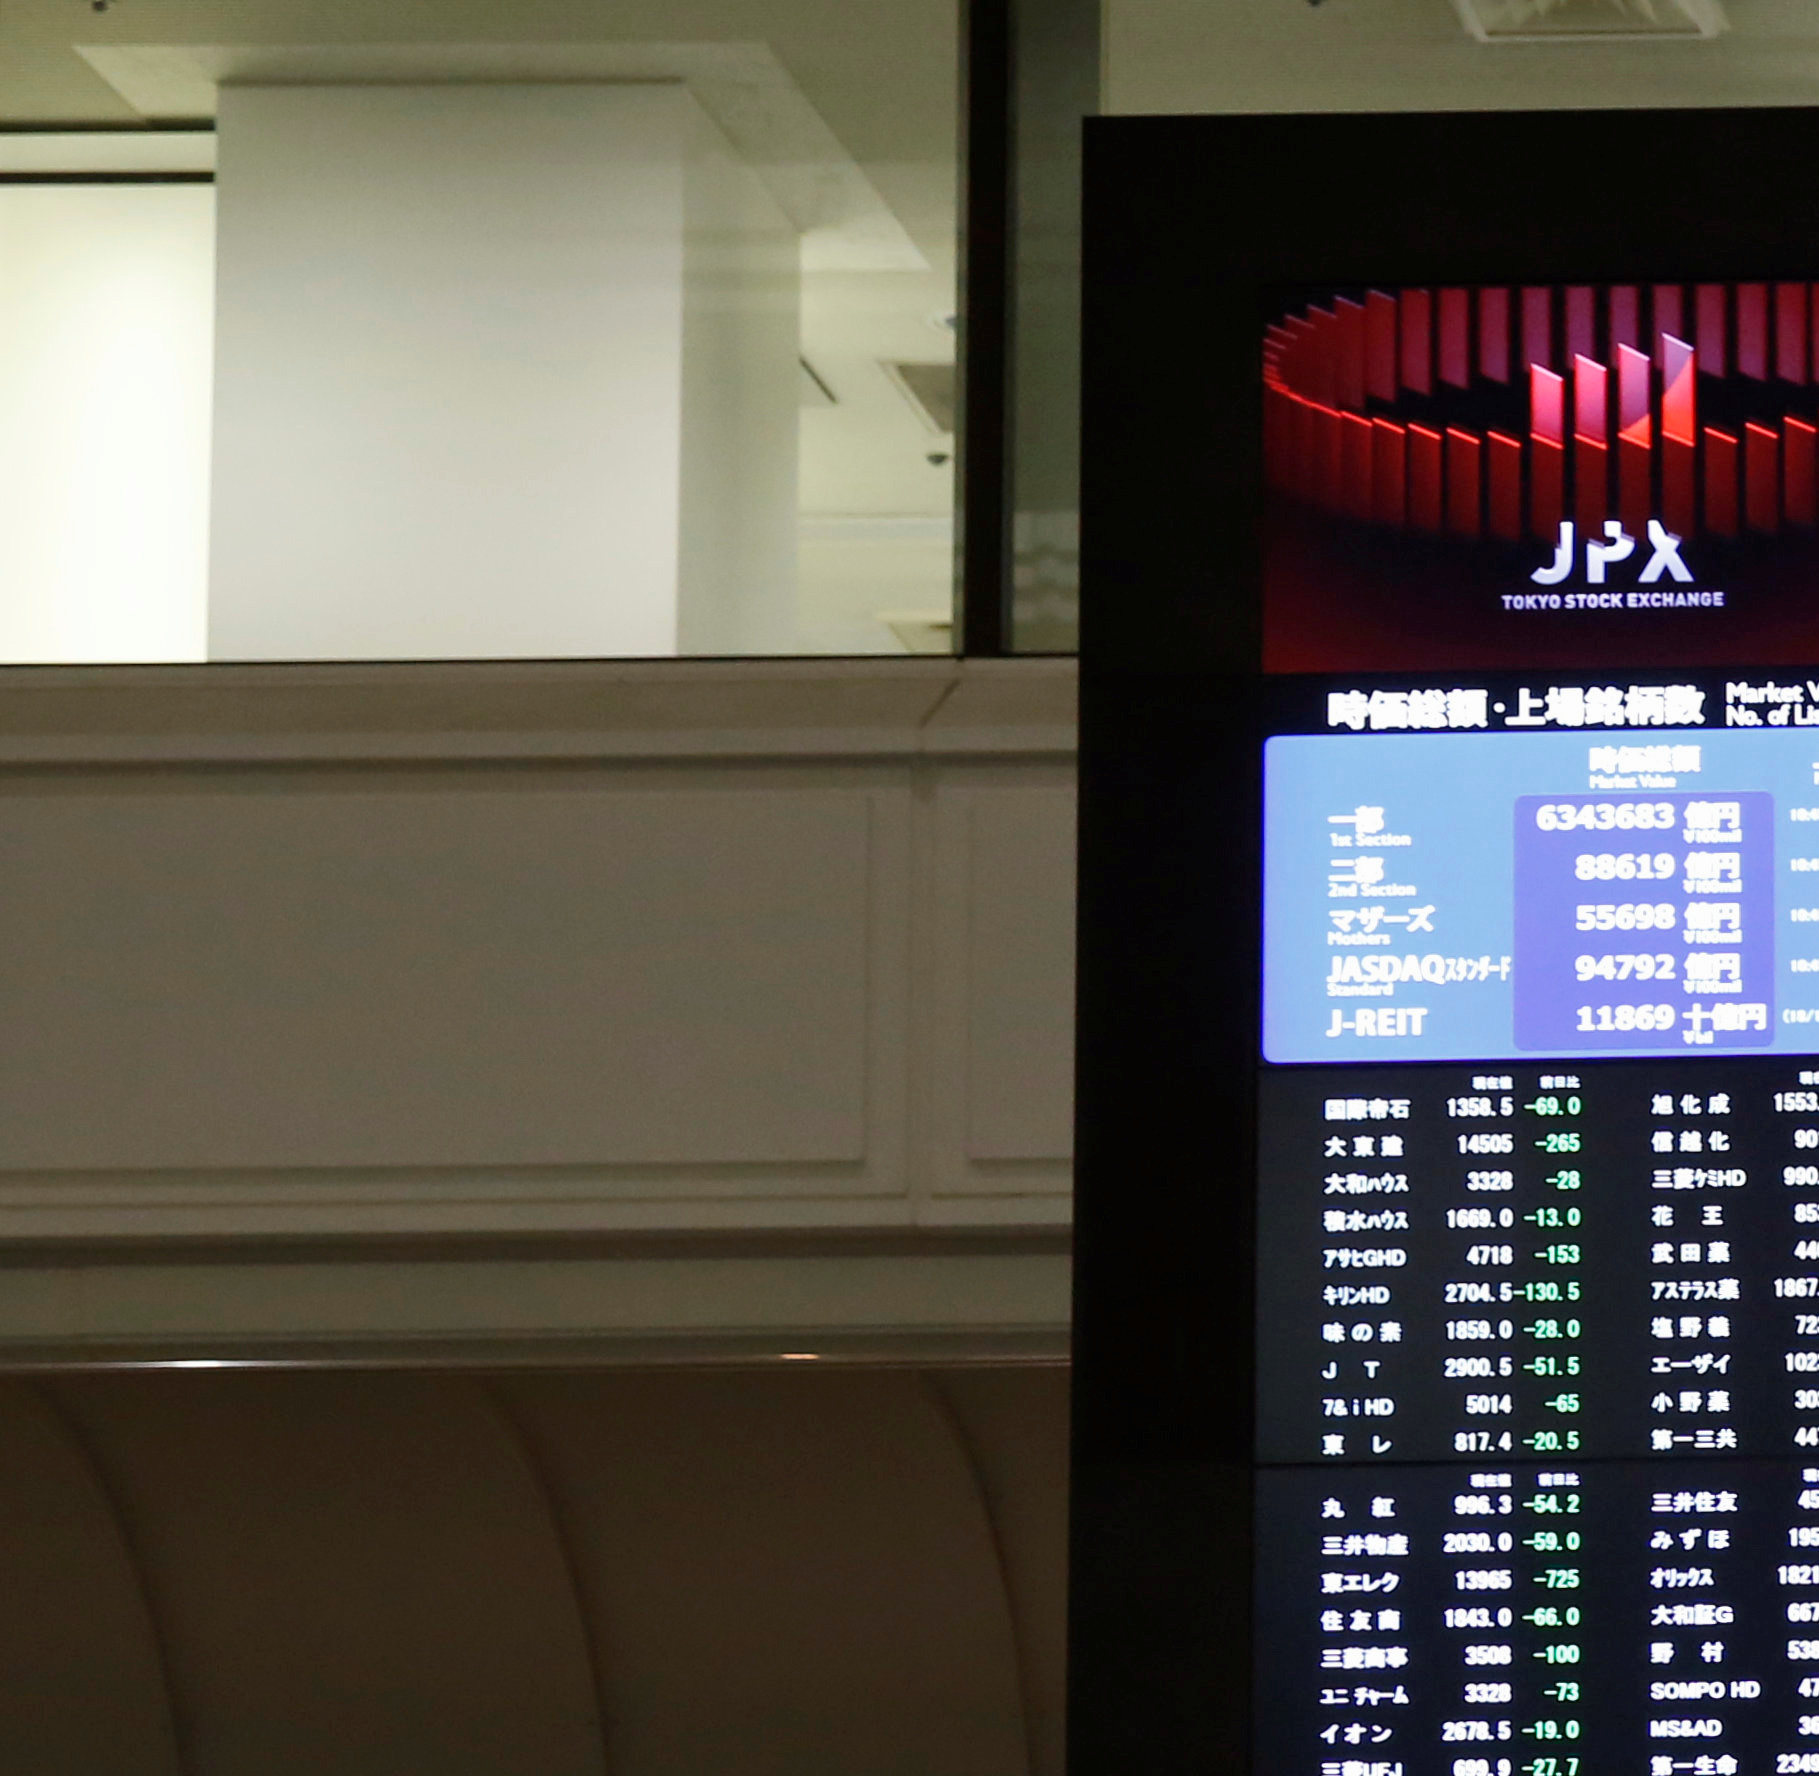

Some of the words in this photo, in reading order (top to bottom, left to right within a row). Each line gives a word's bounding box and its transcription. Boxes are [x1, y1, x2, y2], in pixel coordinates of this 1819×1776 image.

[1531, 520, 1693, 584] JPX
[1502, 595, 1561, 609] TOKYO
[1564, 593, 1623, 608] STOCK
[1627, 592, 1724, 607] EXCHANGE
[1726, 682, 1804, 703] Market
[1726, 705, 1762, 726] No.
[1765, 703, 1789, 724] of
[1328, 806, 1384, 836] 一部
[1537, 803, 1675, 830] 6343683
[1683, 801, 1740, 833] 億円
[1329, 856, 1384, 887] 二部
[1575, 853, 1675, 880] 88619
[1330, 905, 1435, 933] マザーズ
[1576, 904, 1675, 930] 55698
[1327, 955, 1511, 989] JASDAQスタンダード
[1576, 954, 1675, 981] 94792
[1326, 1008, 1427, 1037] J-REIT
[1577, 1004, 1675, 1030] 11869
[1324, 1173, 1409, 1194] 大和ハウス
[1467, 1171, 1513, 1190] 3328
[1546, 1171, 1580, 1189] -28
[1651, 1353, 1730, 1374] エーザイ
[1651, 1491, 1737, 1512] 三井住友
[1650, 1719, 1722, 1737] MS&AD
